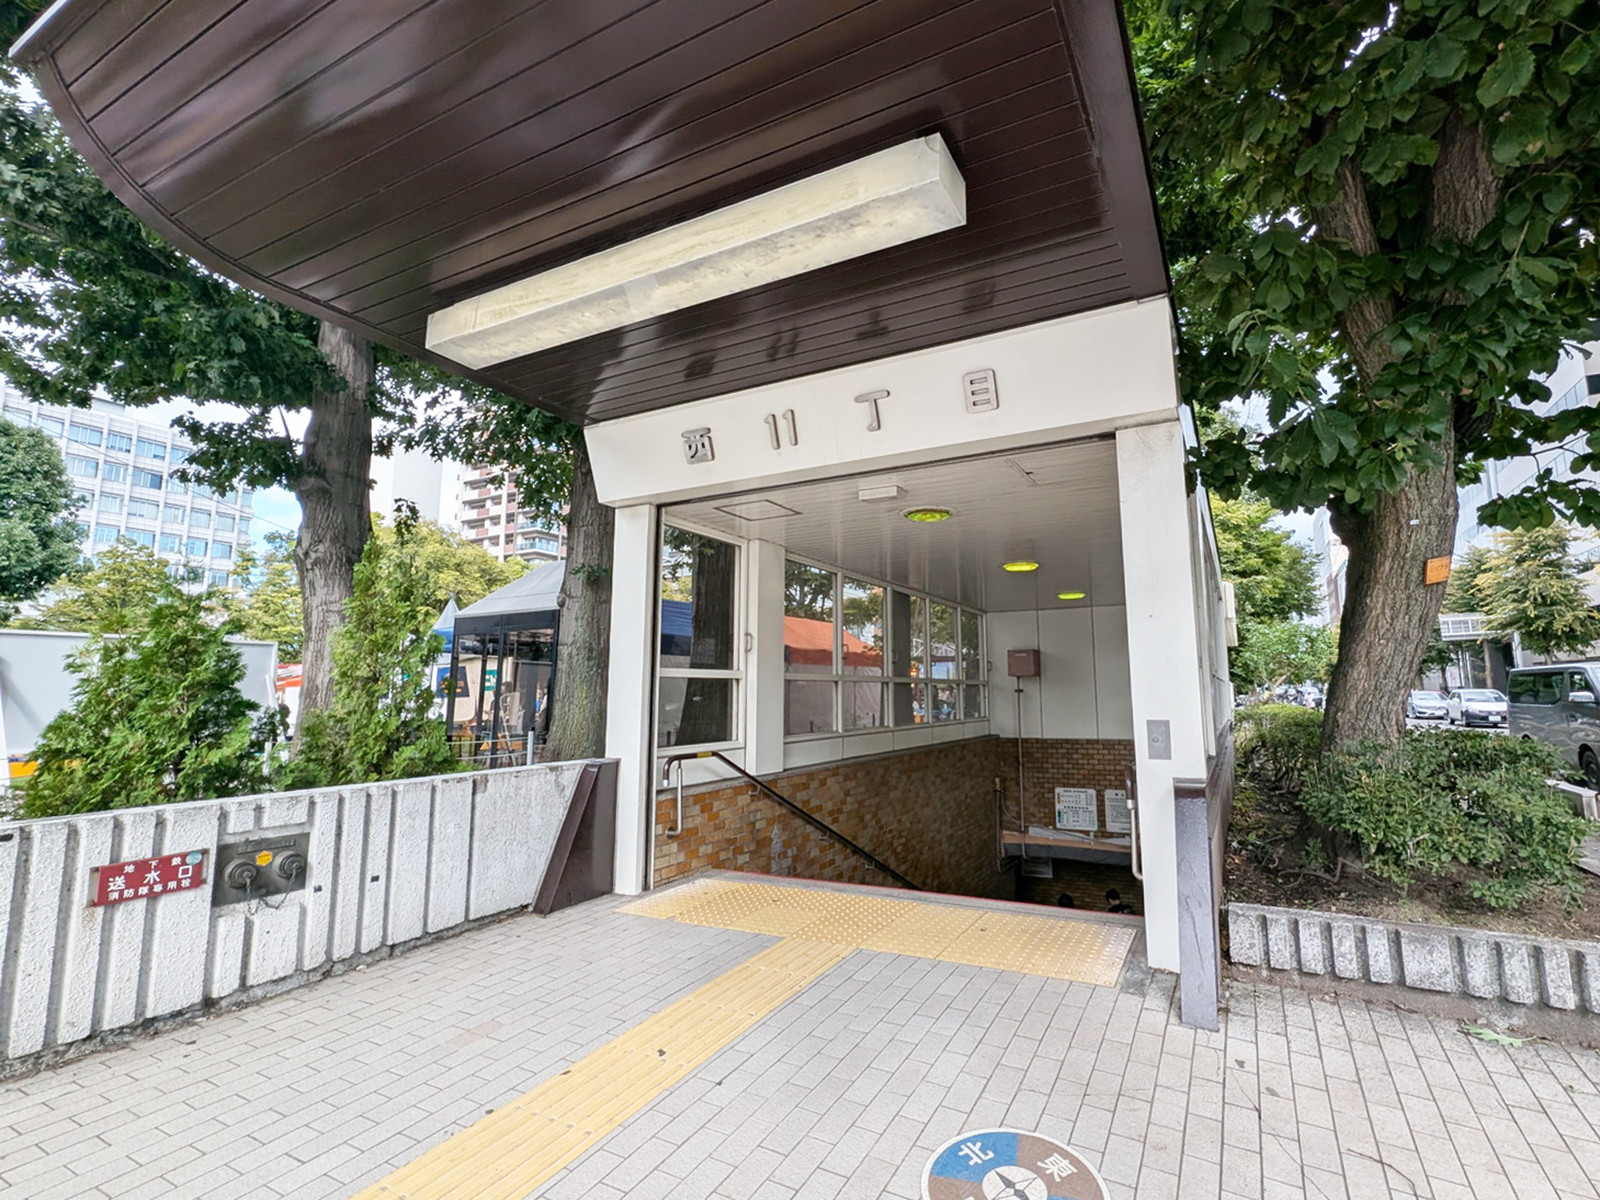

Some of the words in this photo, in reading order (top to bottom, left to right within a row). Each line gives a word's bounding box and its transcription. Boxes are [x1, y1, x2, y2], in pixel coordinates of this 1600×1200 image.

[681, 368, 999, 465] 西11丁目
[107, 864, 192, 891] 送水口
[123, 856, 182, 873] 地下鉄
[957, 1141, 995, 1166] 北
[1036, 1152, 1078, 1182] 東
